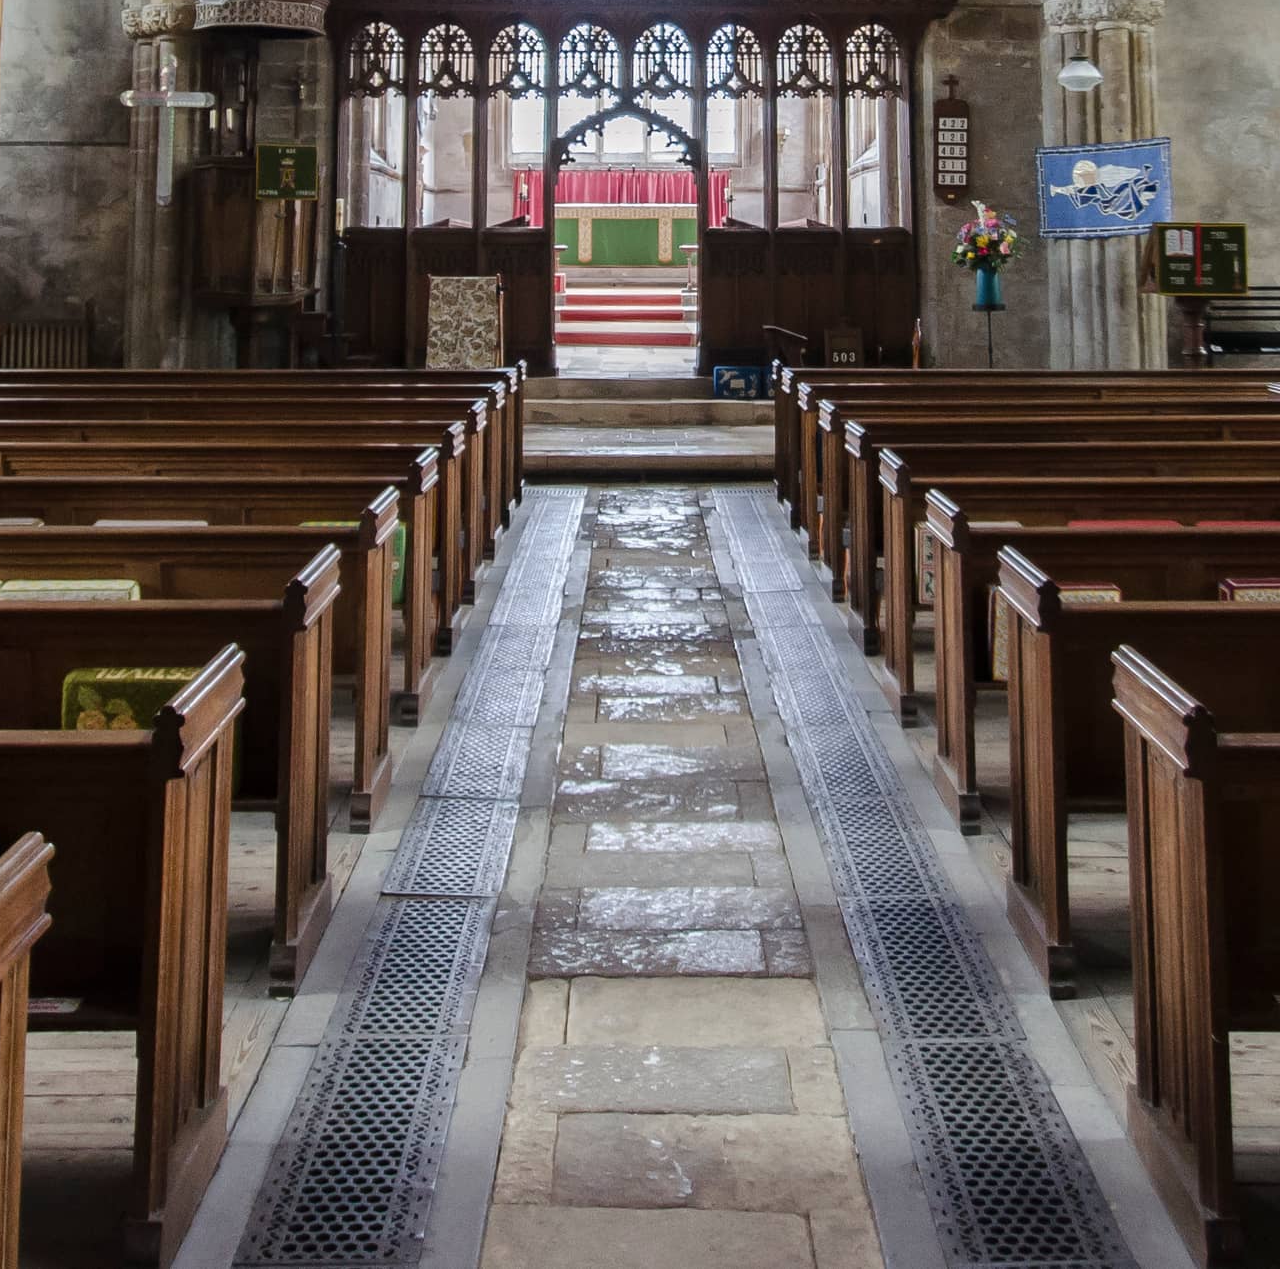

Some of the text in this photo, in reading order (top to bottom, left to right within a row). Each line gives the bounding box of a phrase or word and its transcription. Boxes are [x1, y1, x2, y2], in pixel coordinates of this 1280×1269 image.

[941, 119, 966, 128] 422
[941, 147, 965, 156] 405
[941, 160, 965, 169] 311
